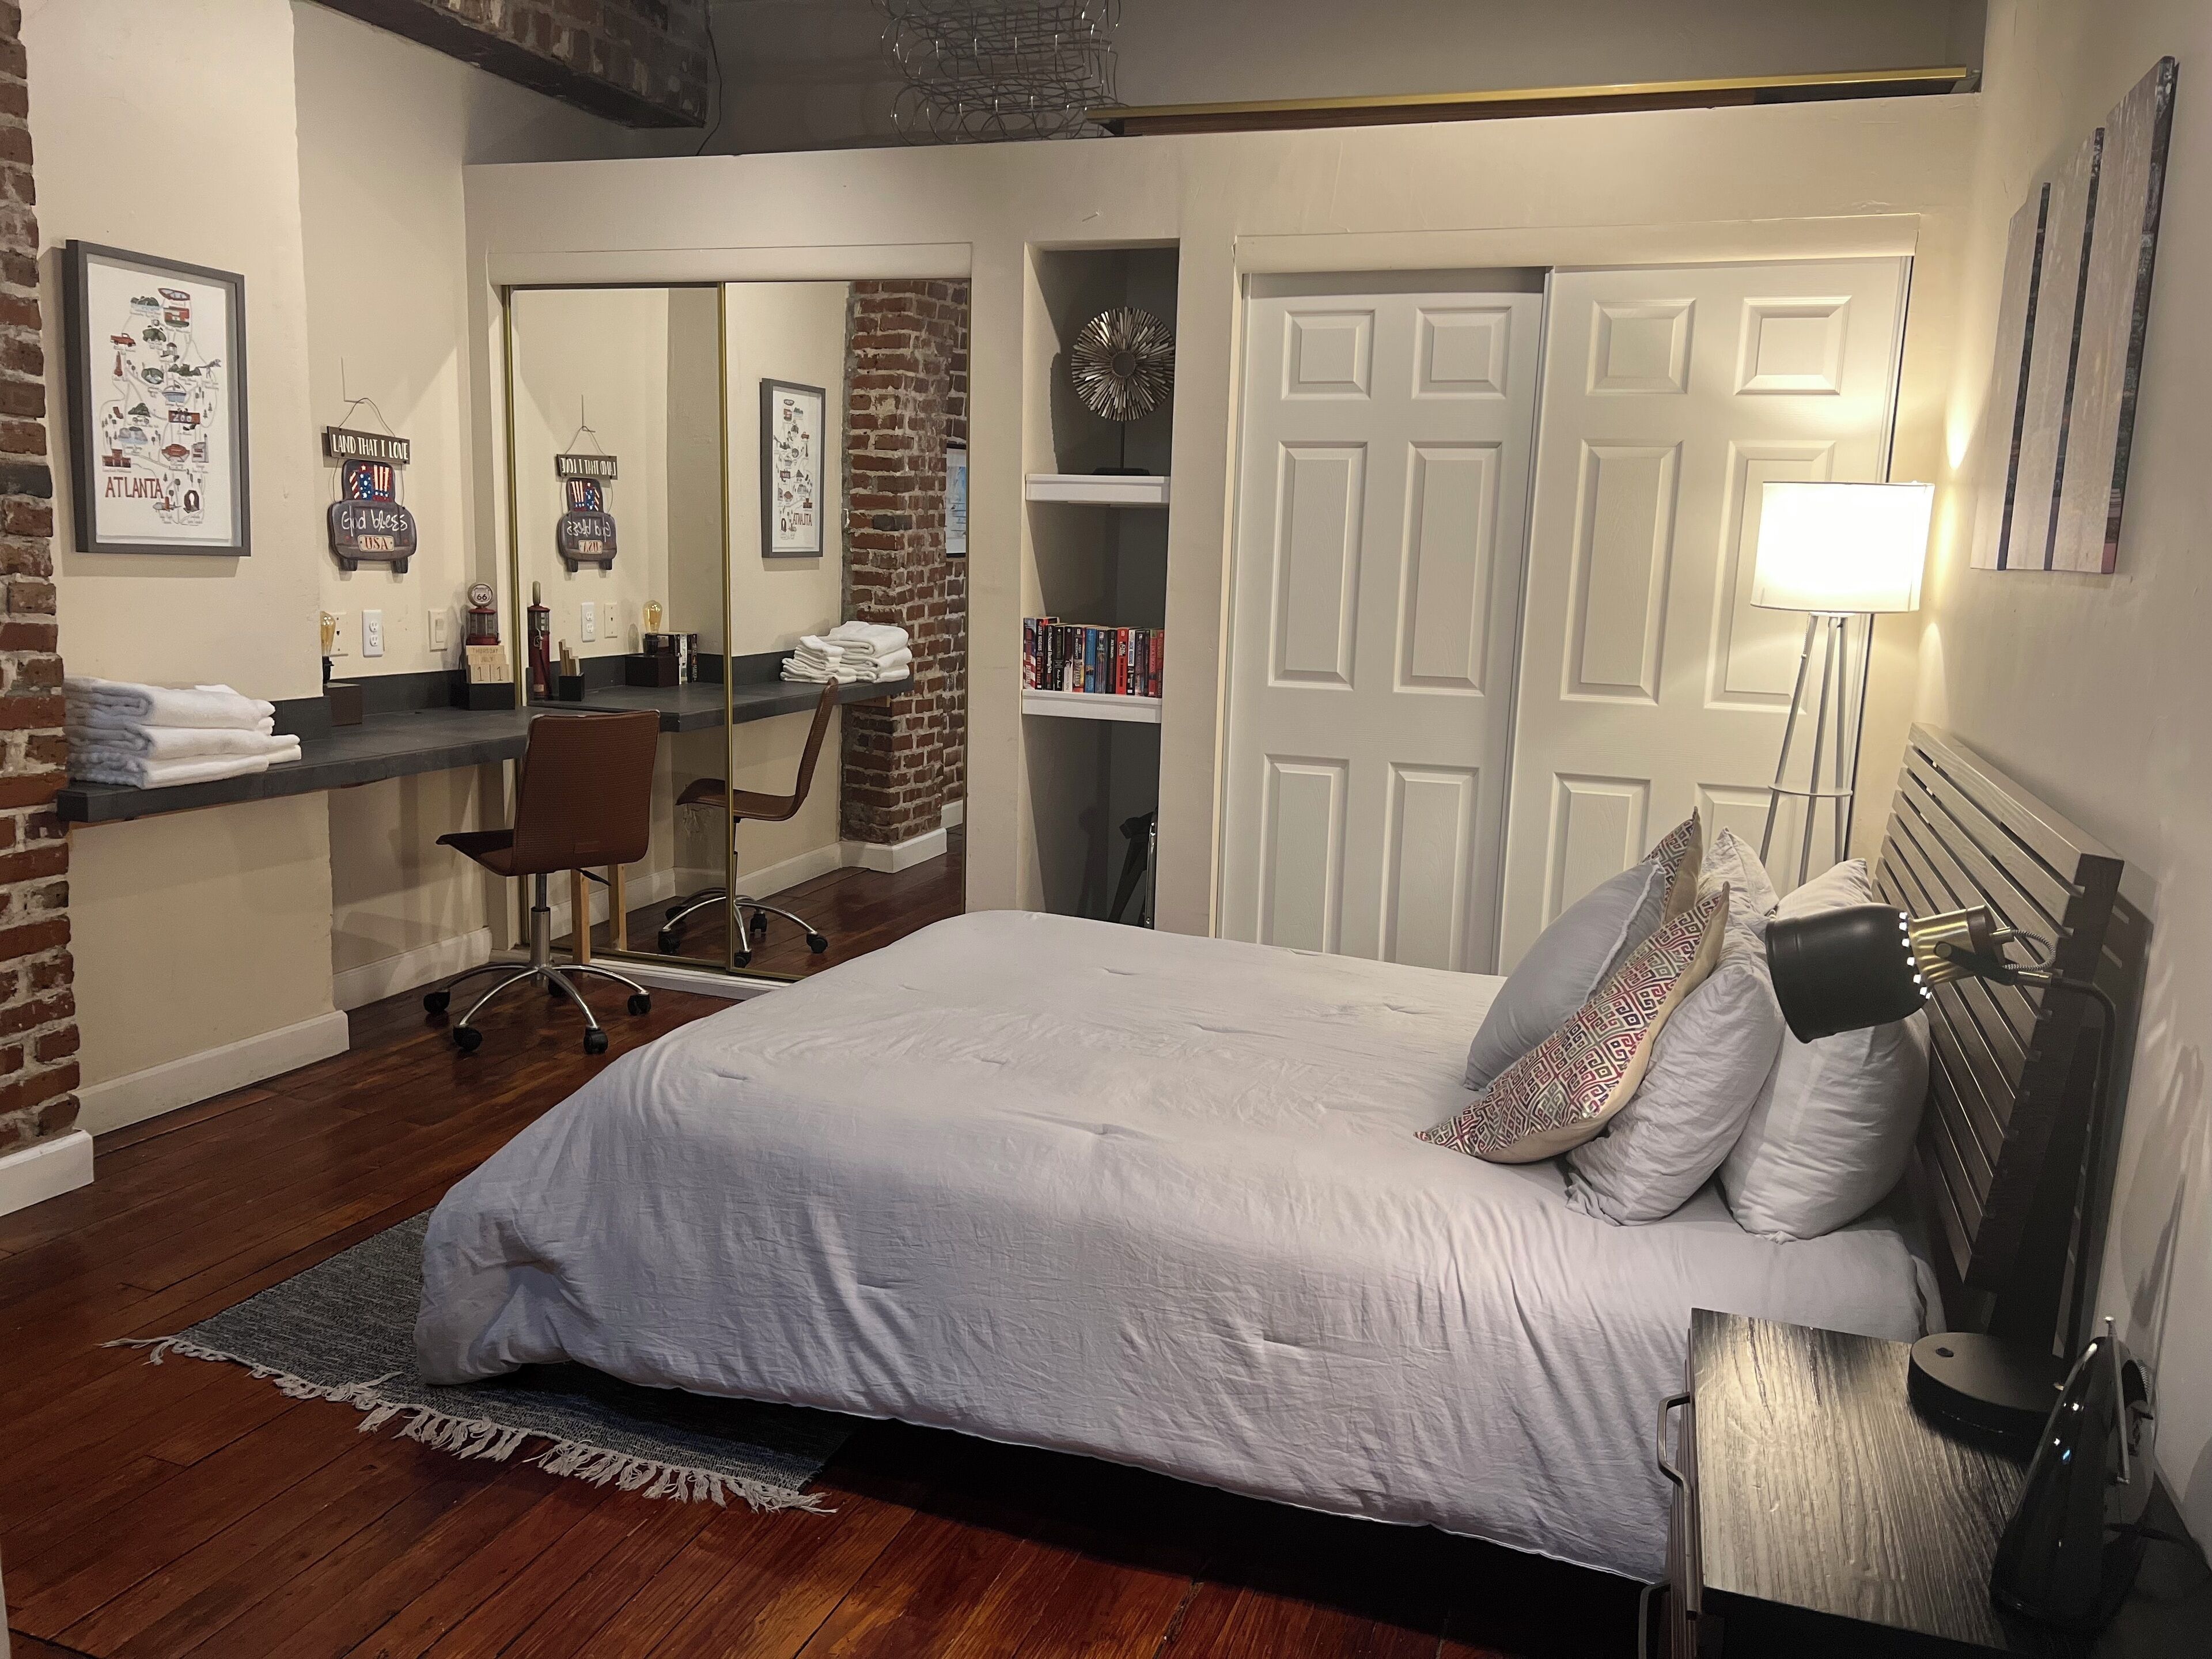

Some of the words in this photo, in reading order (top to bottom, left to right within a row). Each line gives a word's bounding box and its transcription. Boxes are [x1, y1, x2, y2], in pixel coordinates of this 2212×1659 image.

[332, 434, 356, 455] LAND
[357, 437, 378, 457] THAT
[380, 440, 385, 458] I
[388, 441, 409, 460] LOVE
[105, 476, 164, 499] ATLANTA
[341, 510, 366, 537] God
[372, 509, 408, 532] bless
[364, 536, 389, 551] USA
